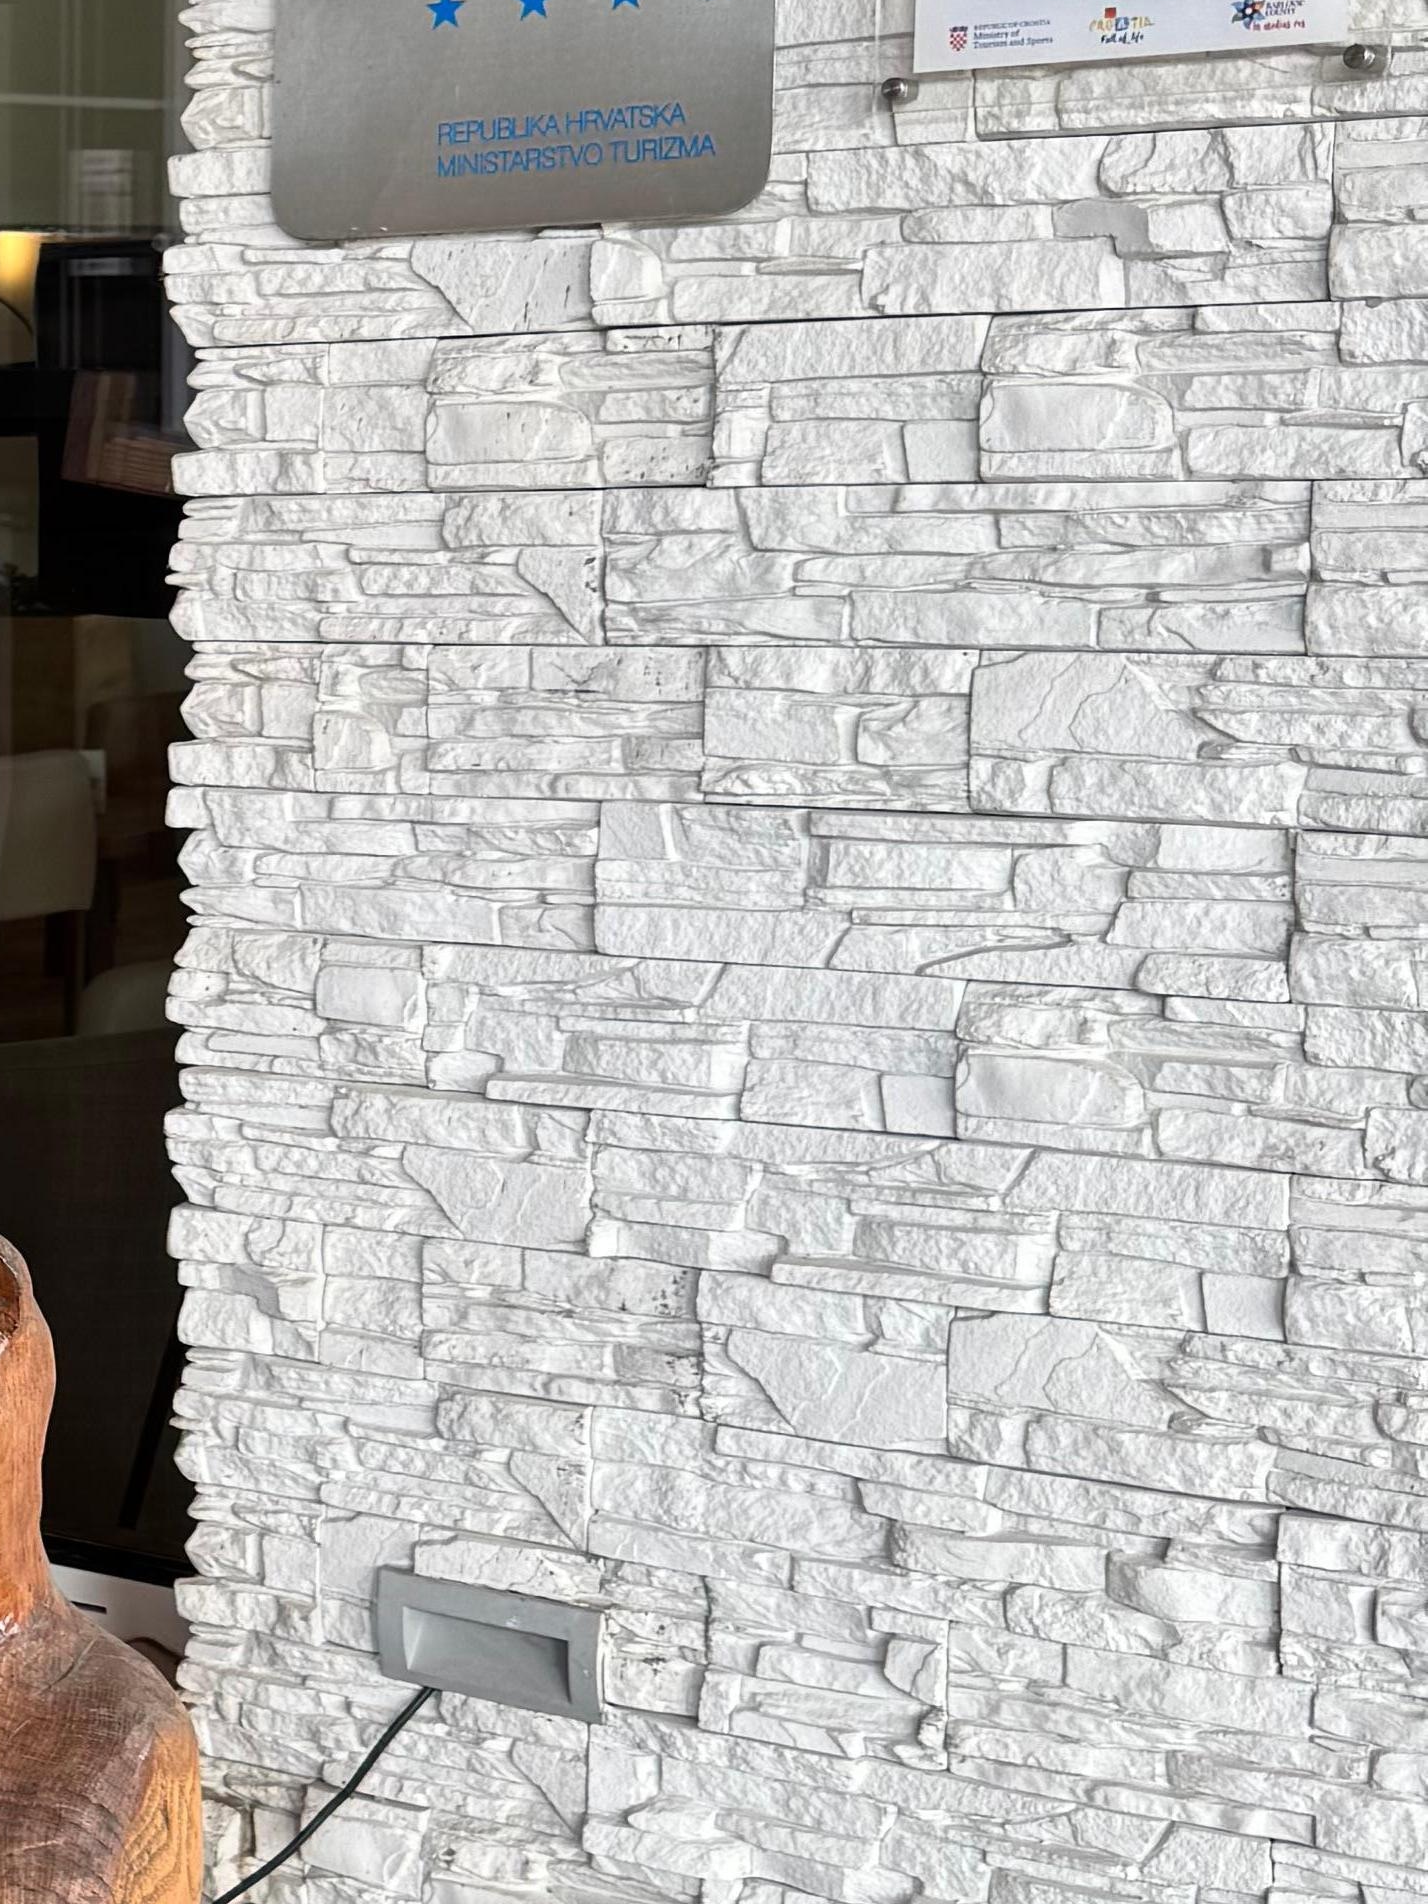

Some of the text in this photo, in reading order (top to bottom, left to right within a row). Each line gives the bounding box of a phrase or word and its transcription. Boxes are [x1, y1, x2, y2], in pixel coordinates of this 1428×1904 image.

[974, 29, 1020, 40] Ministry of
[1009, 37, 1024, 46] and
[438, 101, 687, 145] REPUBLIKA HRVATSKA
[437, 133, 716, 178] MINISTARSTVO TURIZMA
